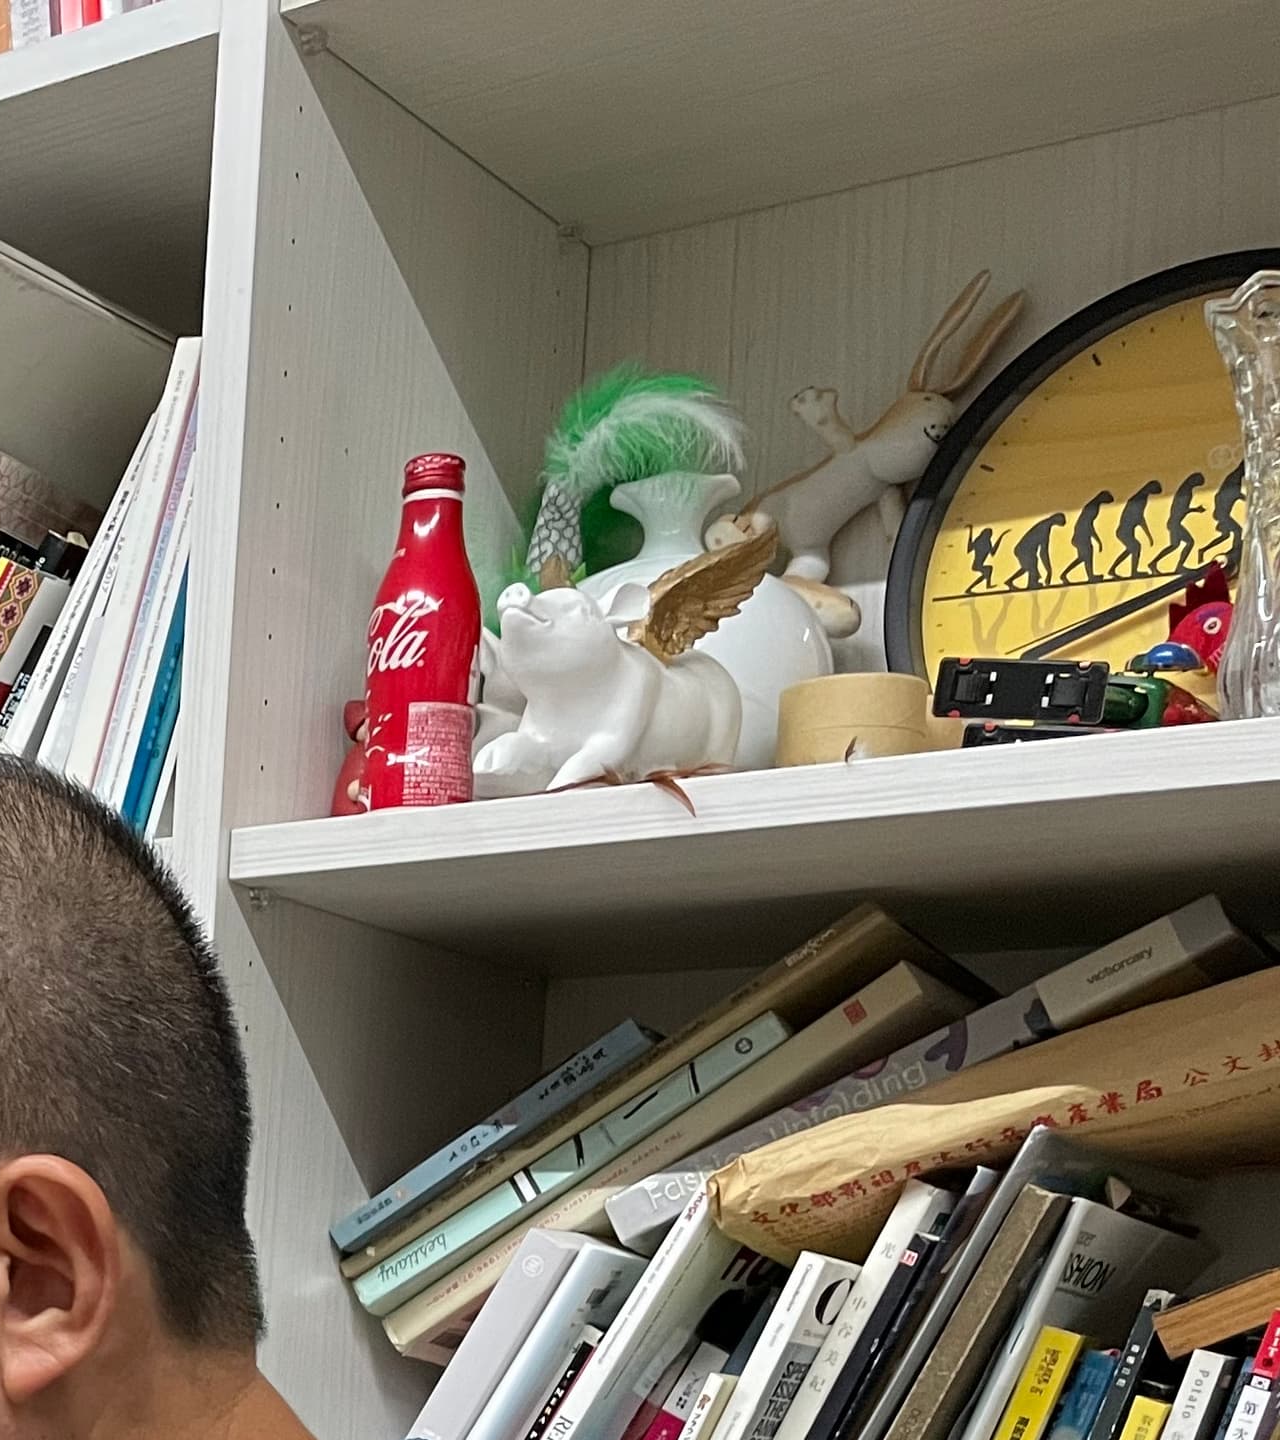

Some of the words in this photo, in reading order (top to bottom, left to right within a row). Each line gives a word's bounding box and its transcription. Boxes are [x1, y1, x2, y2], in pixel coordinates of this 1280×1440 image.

[163, 477, 185, 522] Made
[373, 1229, 451, 1289] bestiary
[1182, 1368, 1211, 1419] Potato
